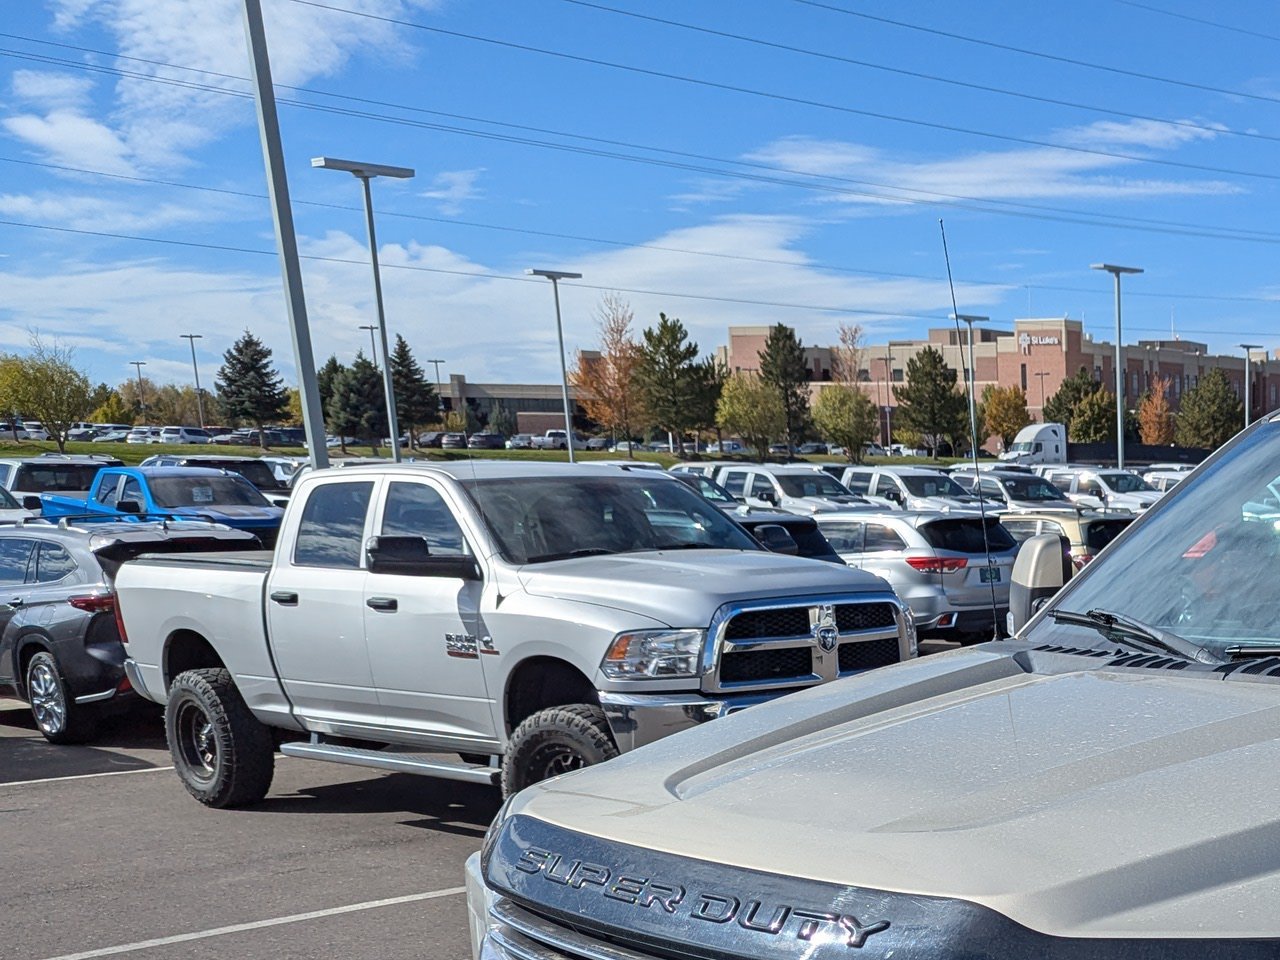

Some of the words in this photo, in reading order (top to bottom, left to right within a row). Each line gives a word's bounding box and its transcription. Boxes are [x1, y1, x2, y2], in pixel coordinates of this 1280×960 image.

[1038, 336, 1058, 344] Luke's
[515, 846, 686, 914] SUPER
[690, 892, 891, 949] DUTY
